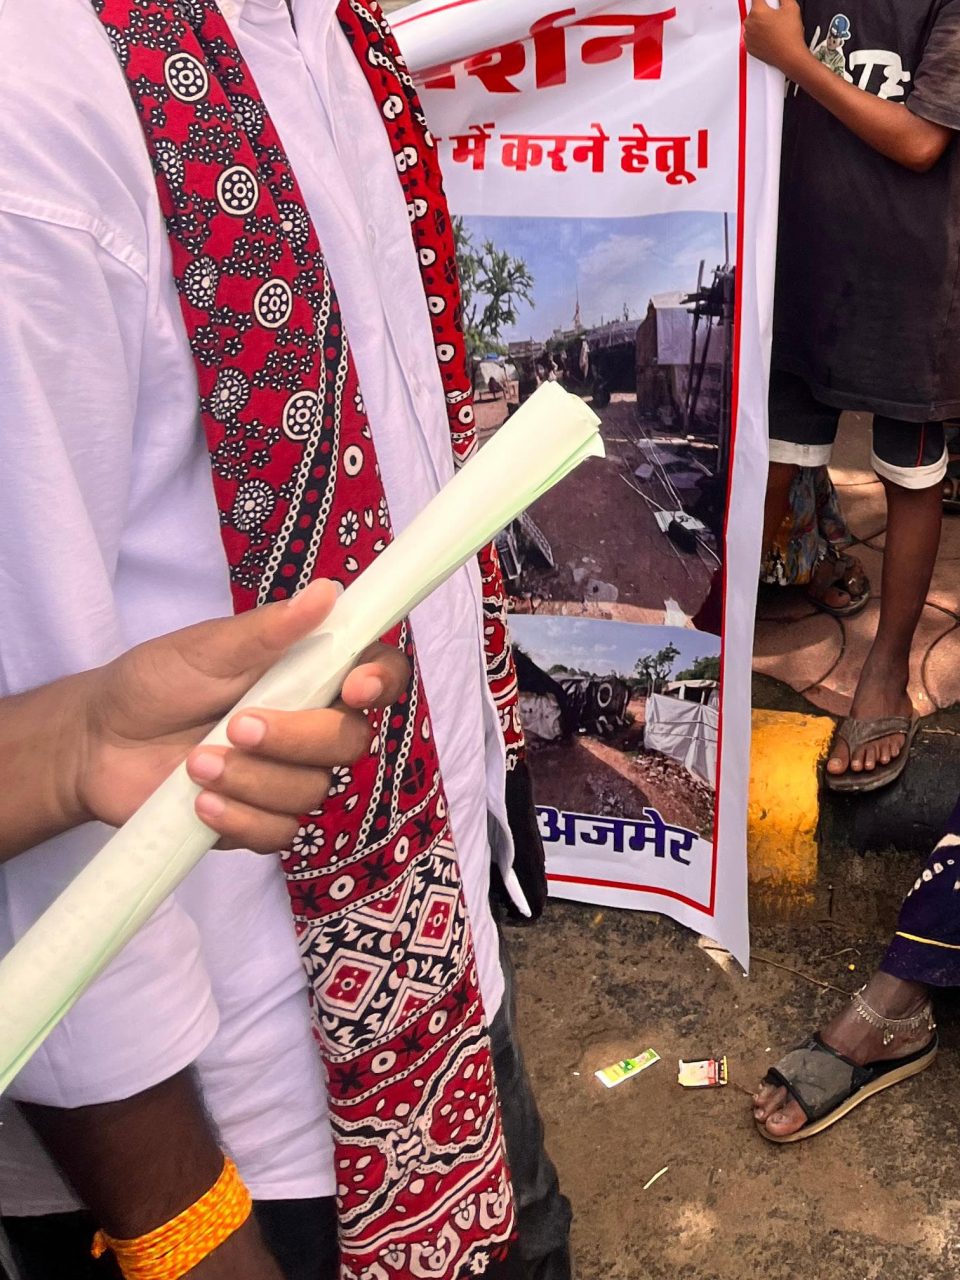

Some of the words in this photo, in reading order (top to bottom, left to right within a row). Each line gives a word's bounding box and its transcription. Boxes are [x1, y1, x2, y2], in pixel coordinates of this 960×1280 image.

[449, 122, 496, 171] में
[500, 123, 610, 173] करने
[535, 806, 699, 866] अजमेर
